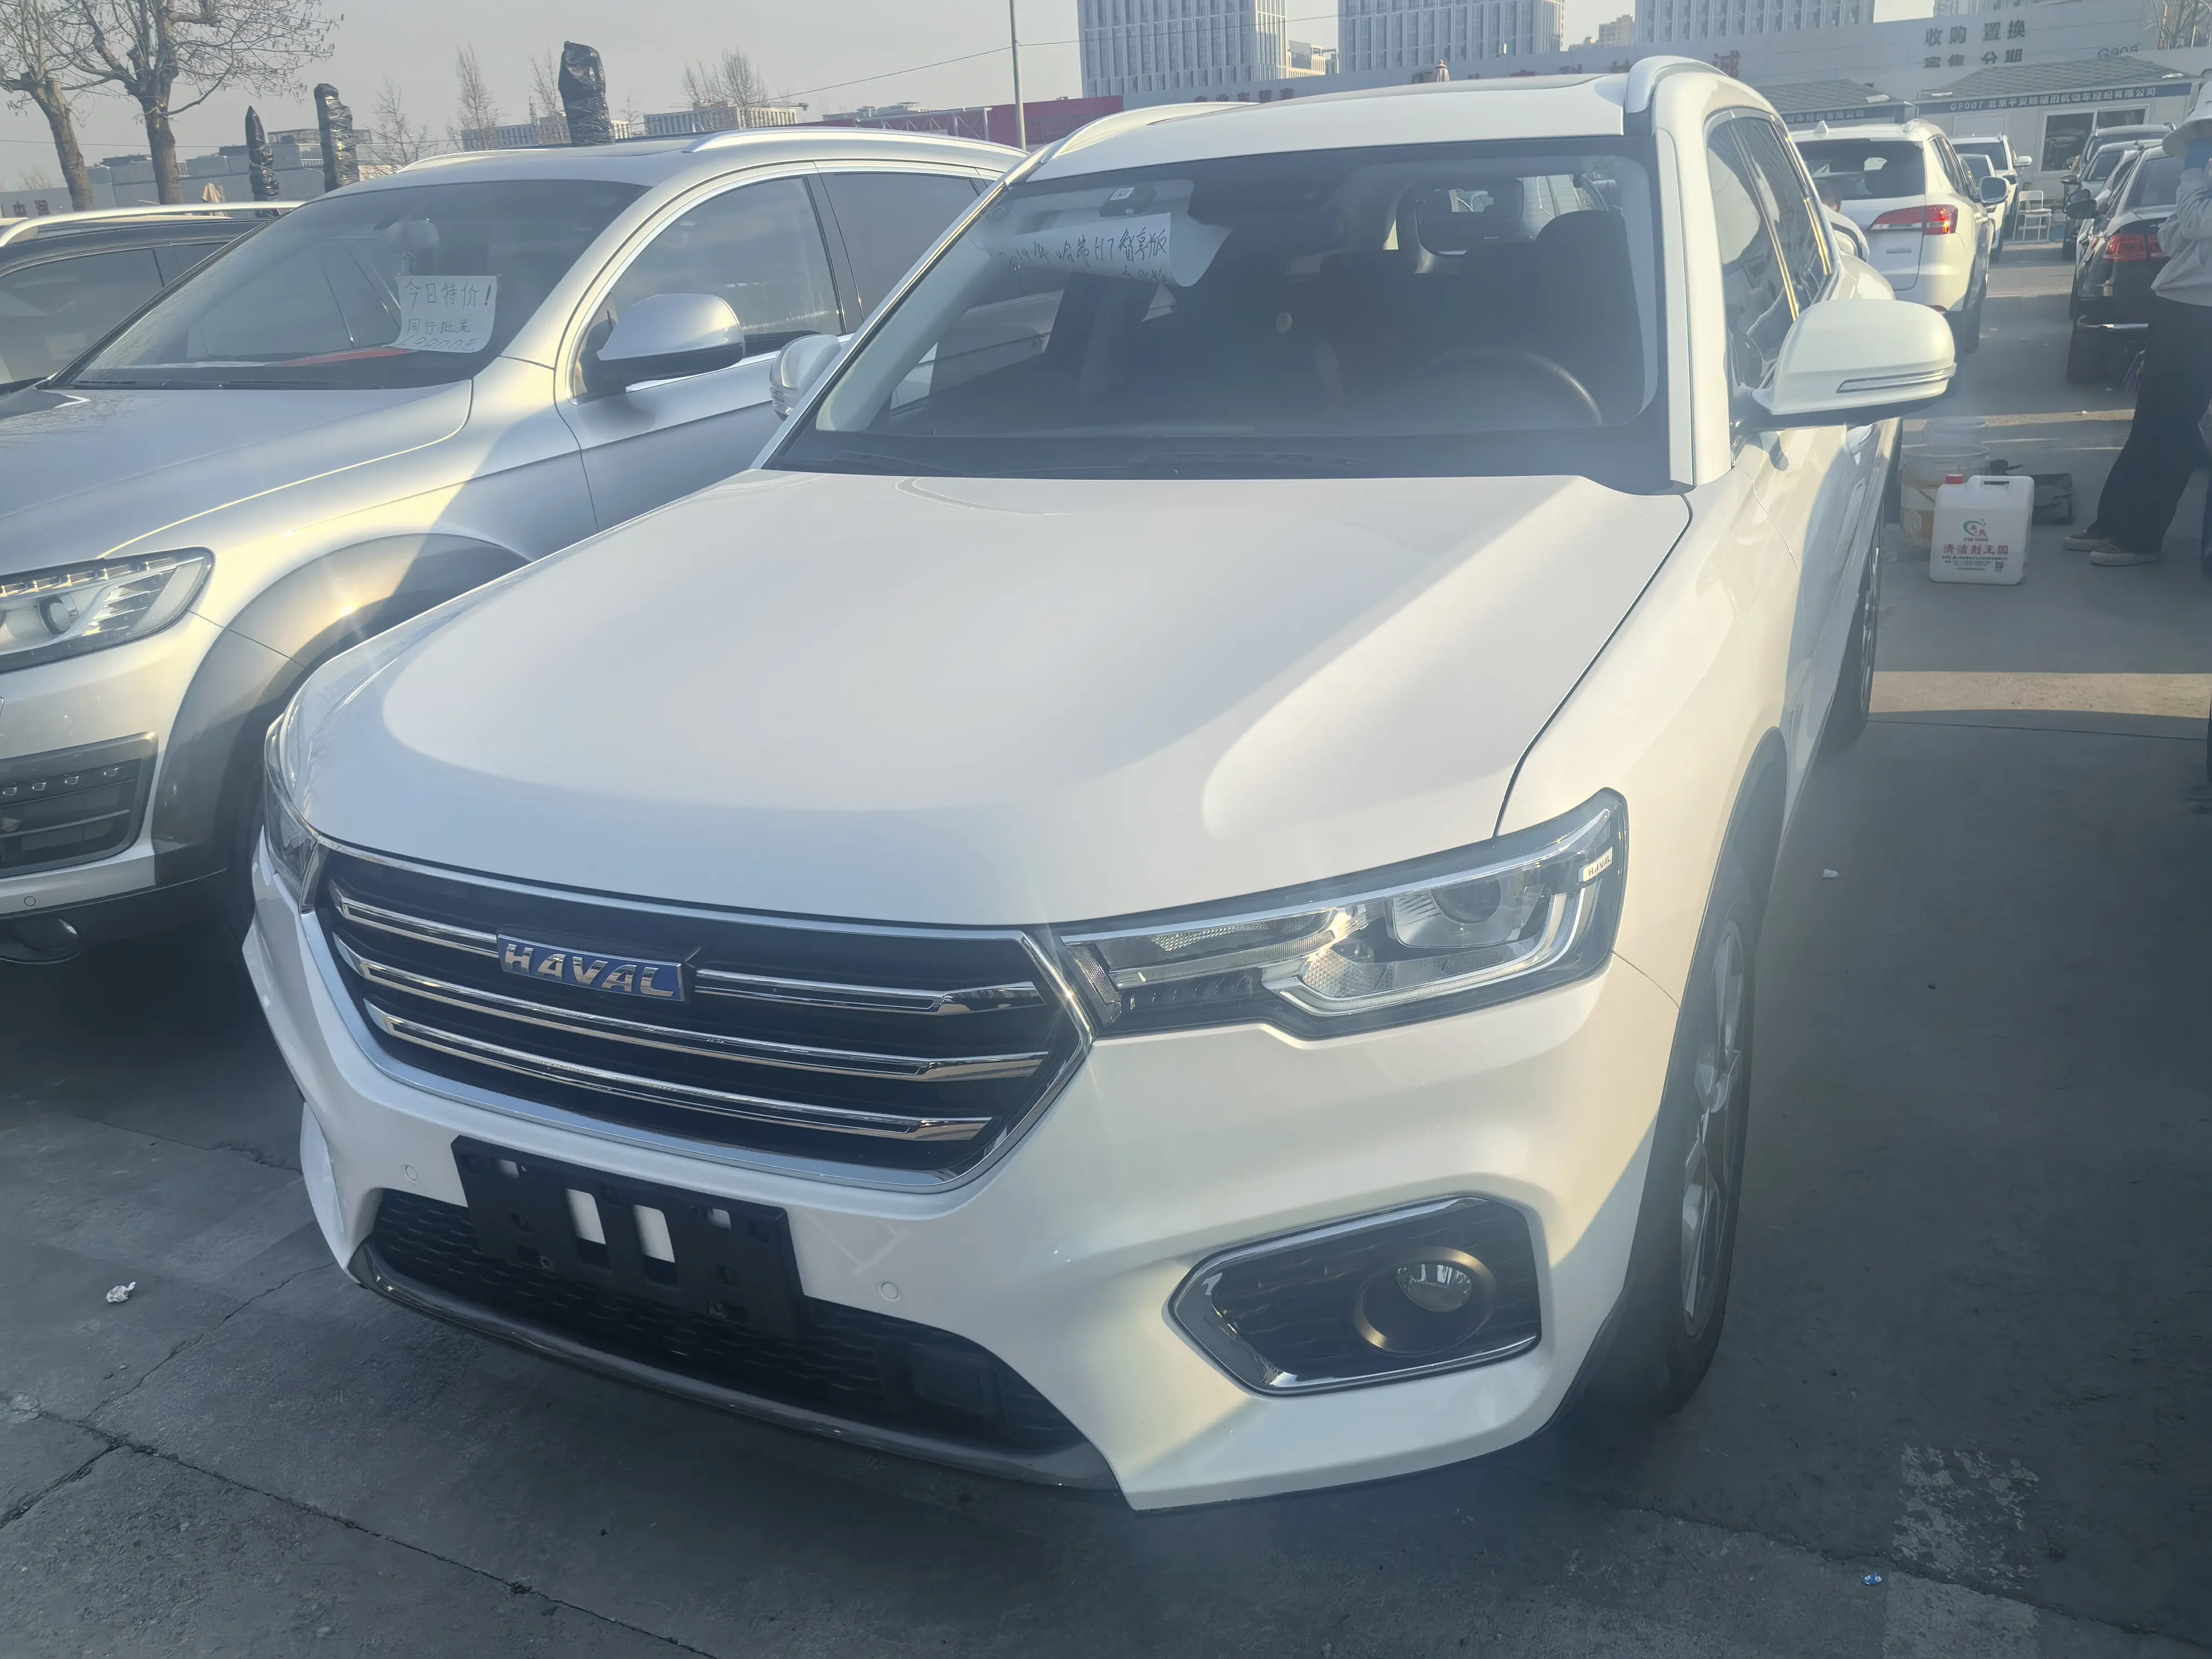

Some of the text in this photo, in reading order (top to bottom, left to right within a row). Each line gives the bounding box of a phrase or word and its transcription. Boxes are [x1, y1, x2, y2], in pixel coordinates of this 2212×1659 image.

[1925, 19, 2026, 47] 收购 置换
[1951, 101, 1984, 110] GF007
[407, 318, 471, 335] 同行批发
[1588, 855, 1611, 876] HAVAL
[504, 943, 674, 997] HAVAL
